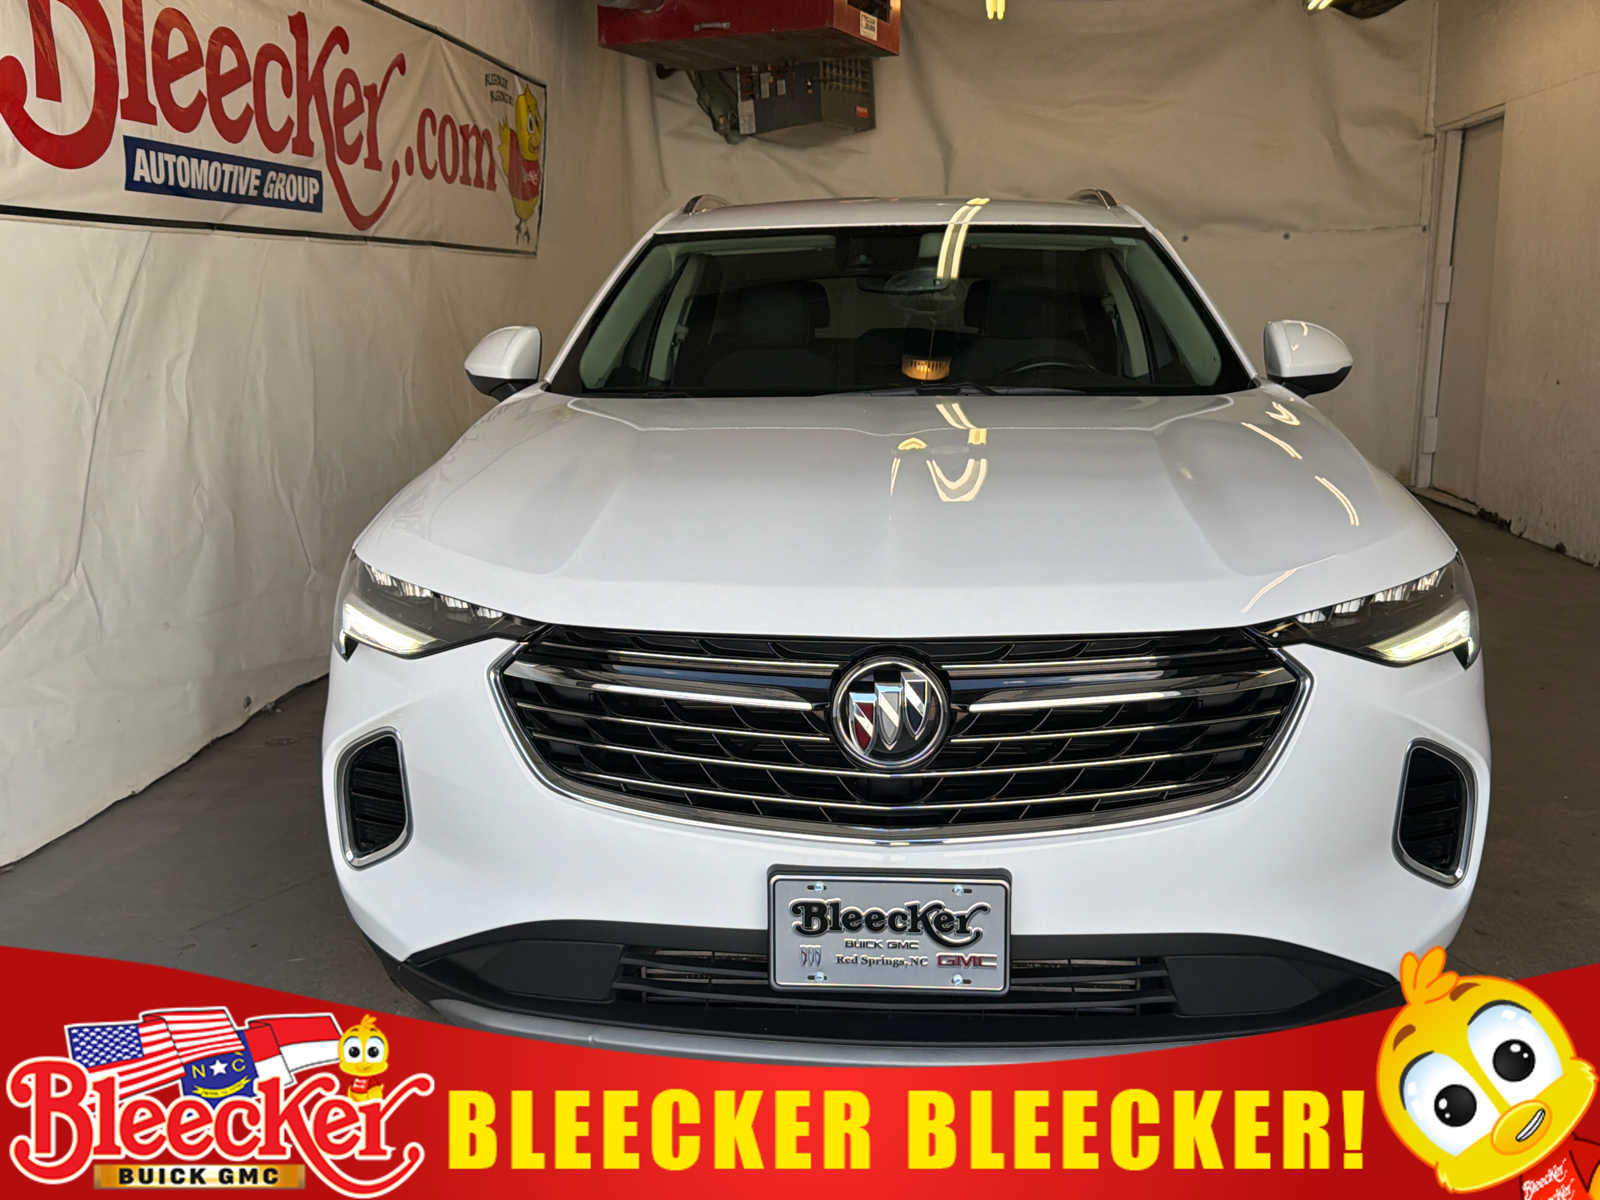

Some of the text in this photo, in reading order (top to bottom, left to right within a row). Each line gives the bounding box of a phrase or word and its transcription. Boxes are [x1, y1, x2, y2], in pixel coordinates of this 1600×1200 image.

[133, 148, 320, 205] AUTOMOTIVE GROUP
[844, 938, 920, 950] BUICK GMC
[836, 954, 860, 966] Red
[910, 955, 929, 967] NC
[936, 953, 998, 969] GMC
